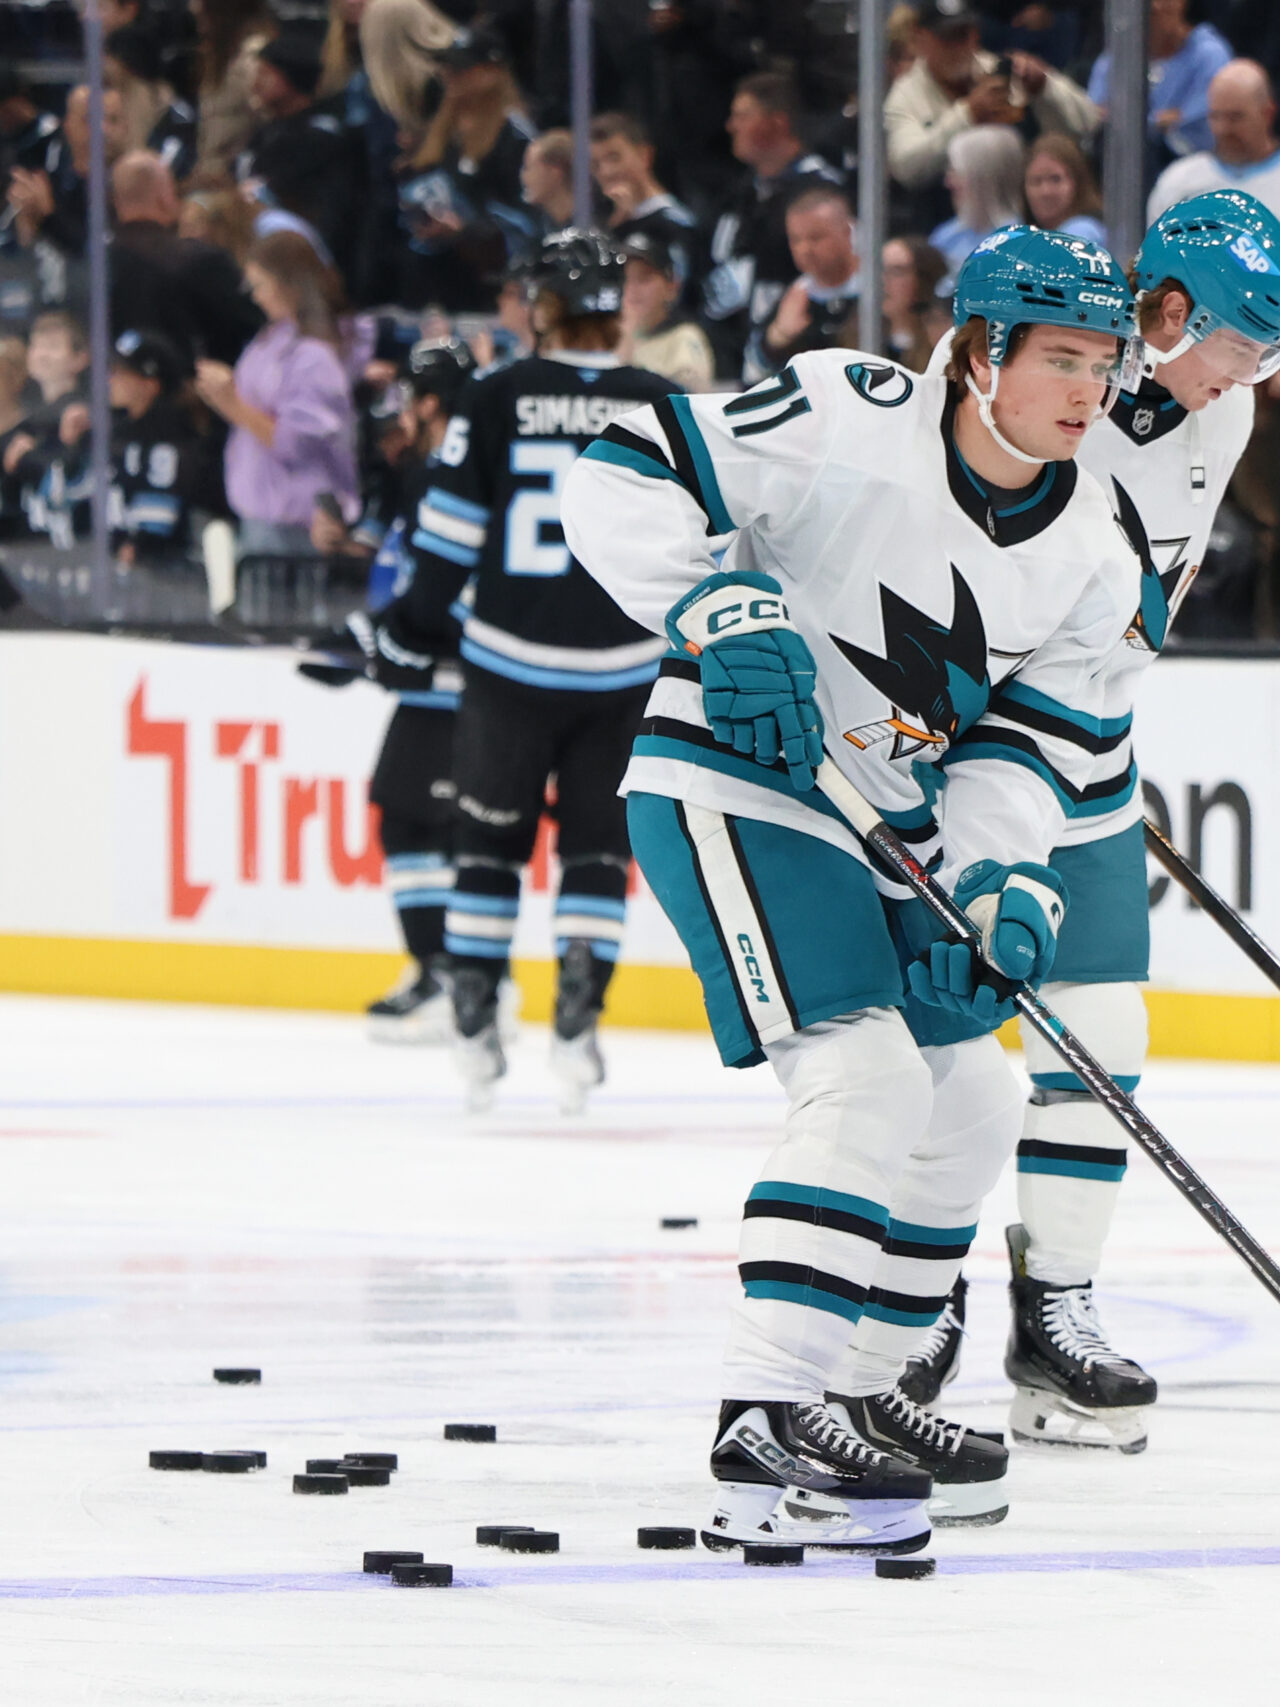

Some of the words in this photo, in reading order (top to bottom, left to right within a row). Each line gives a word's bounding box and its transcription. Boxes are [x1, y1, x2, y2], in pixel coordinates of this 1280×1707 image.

[1229, 235, 1270, 273] SAP
[1078, 291, 1123, 309] CCM
[516, 394, 640, 435] SIMAS
[722, 365, 812, 439] 71
[736, 932, 771, 1004] CCM
[736, 1424, 815, 1485] CCM
